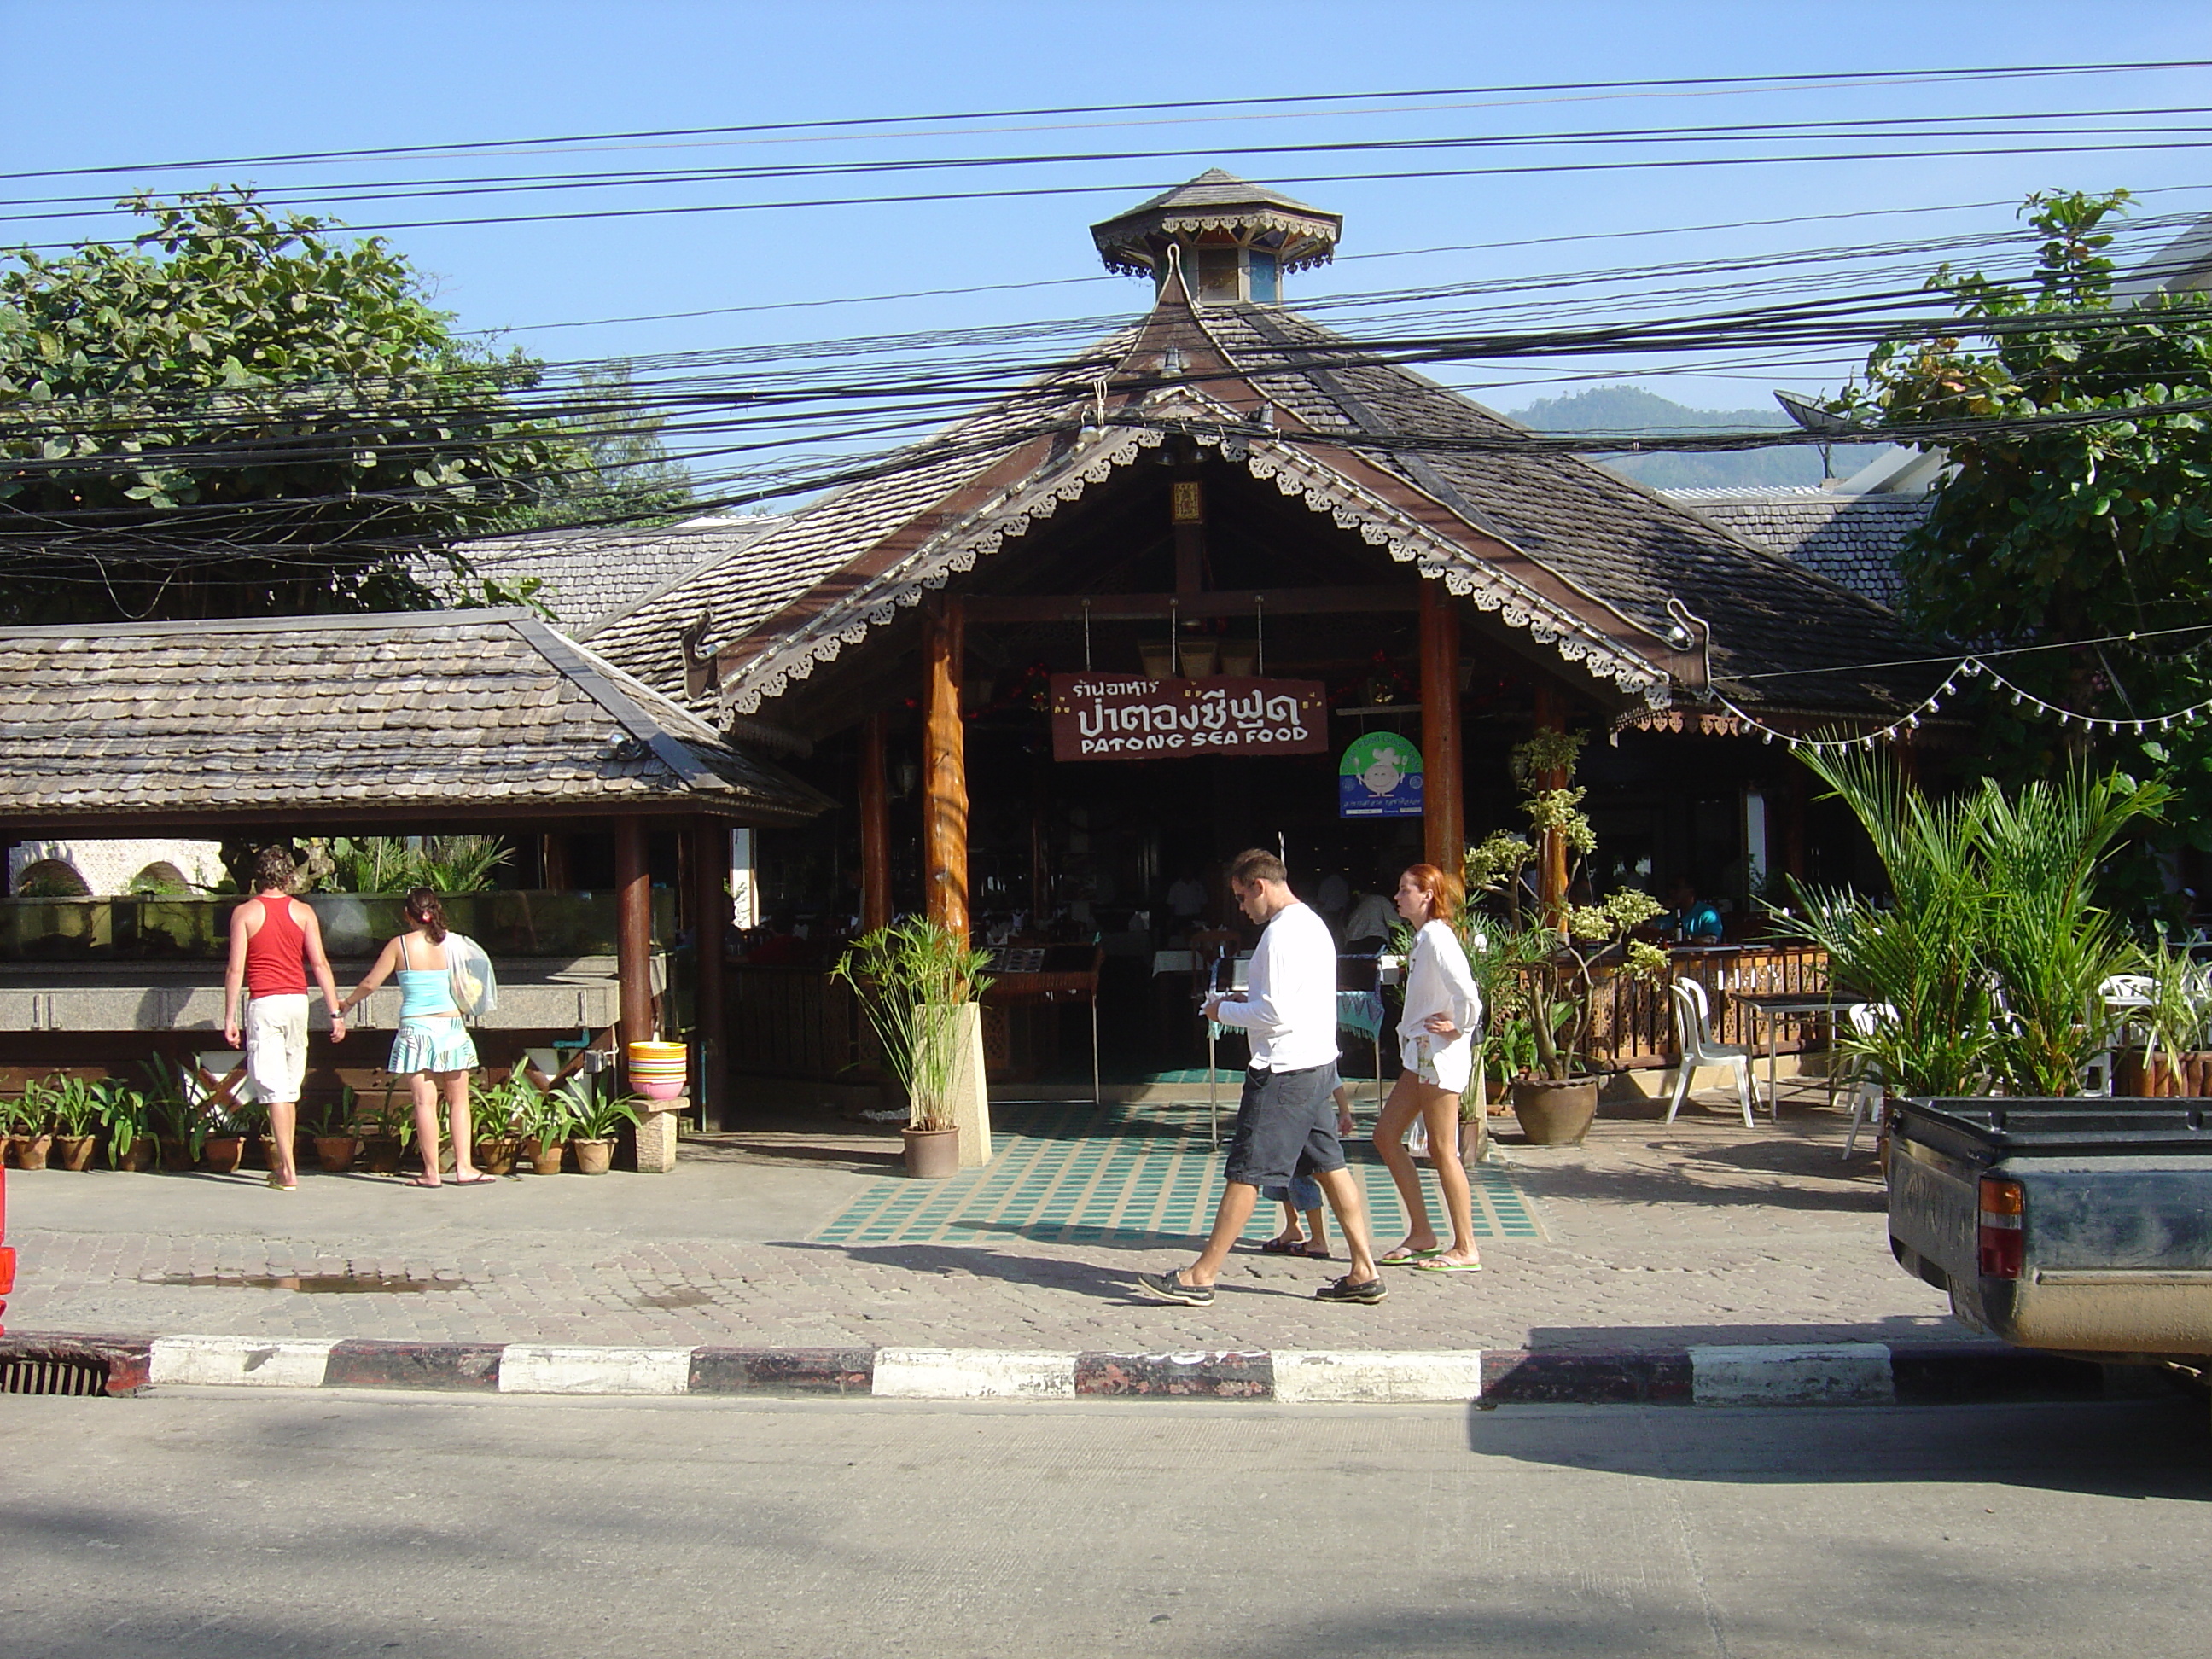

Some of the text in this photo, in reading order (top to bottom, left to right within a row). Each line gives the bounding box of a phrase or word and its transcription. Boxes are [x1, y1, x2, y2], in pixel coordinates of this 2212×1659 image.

[1072, 678, 1160, 698] ร้านอาหาร
[1078, 689, 1301, 737] ป่าตองซีฟูด
[1081, 726, 1308, 754] PATONG SEA FOOD
